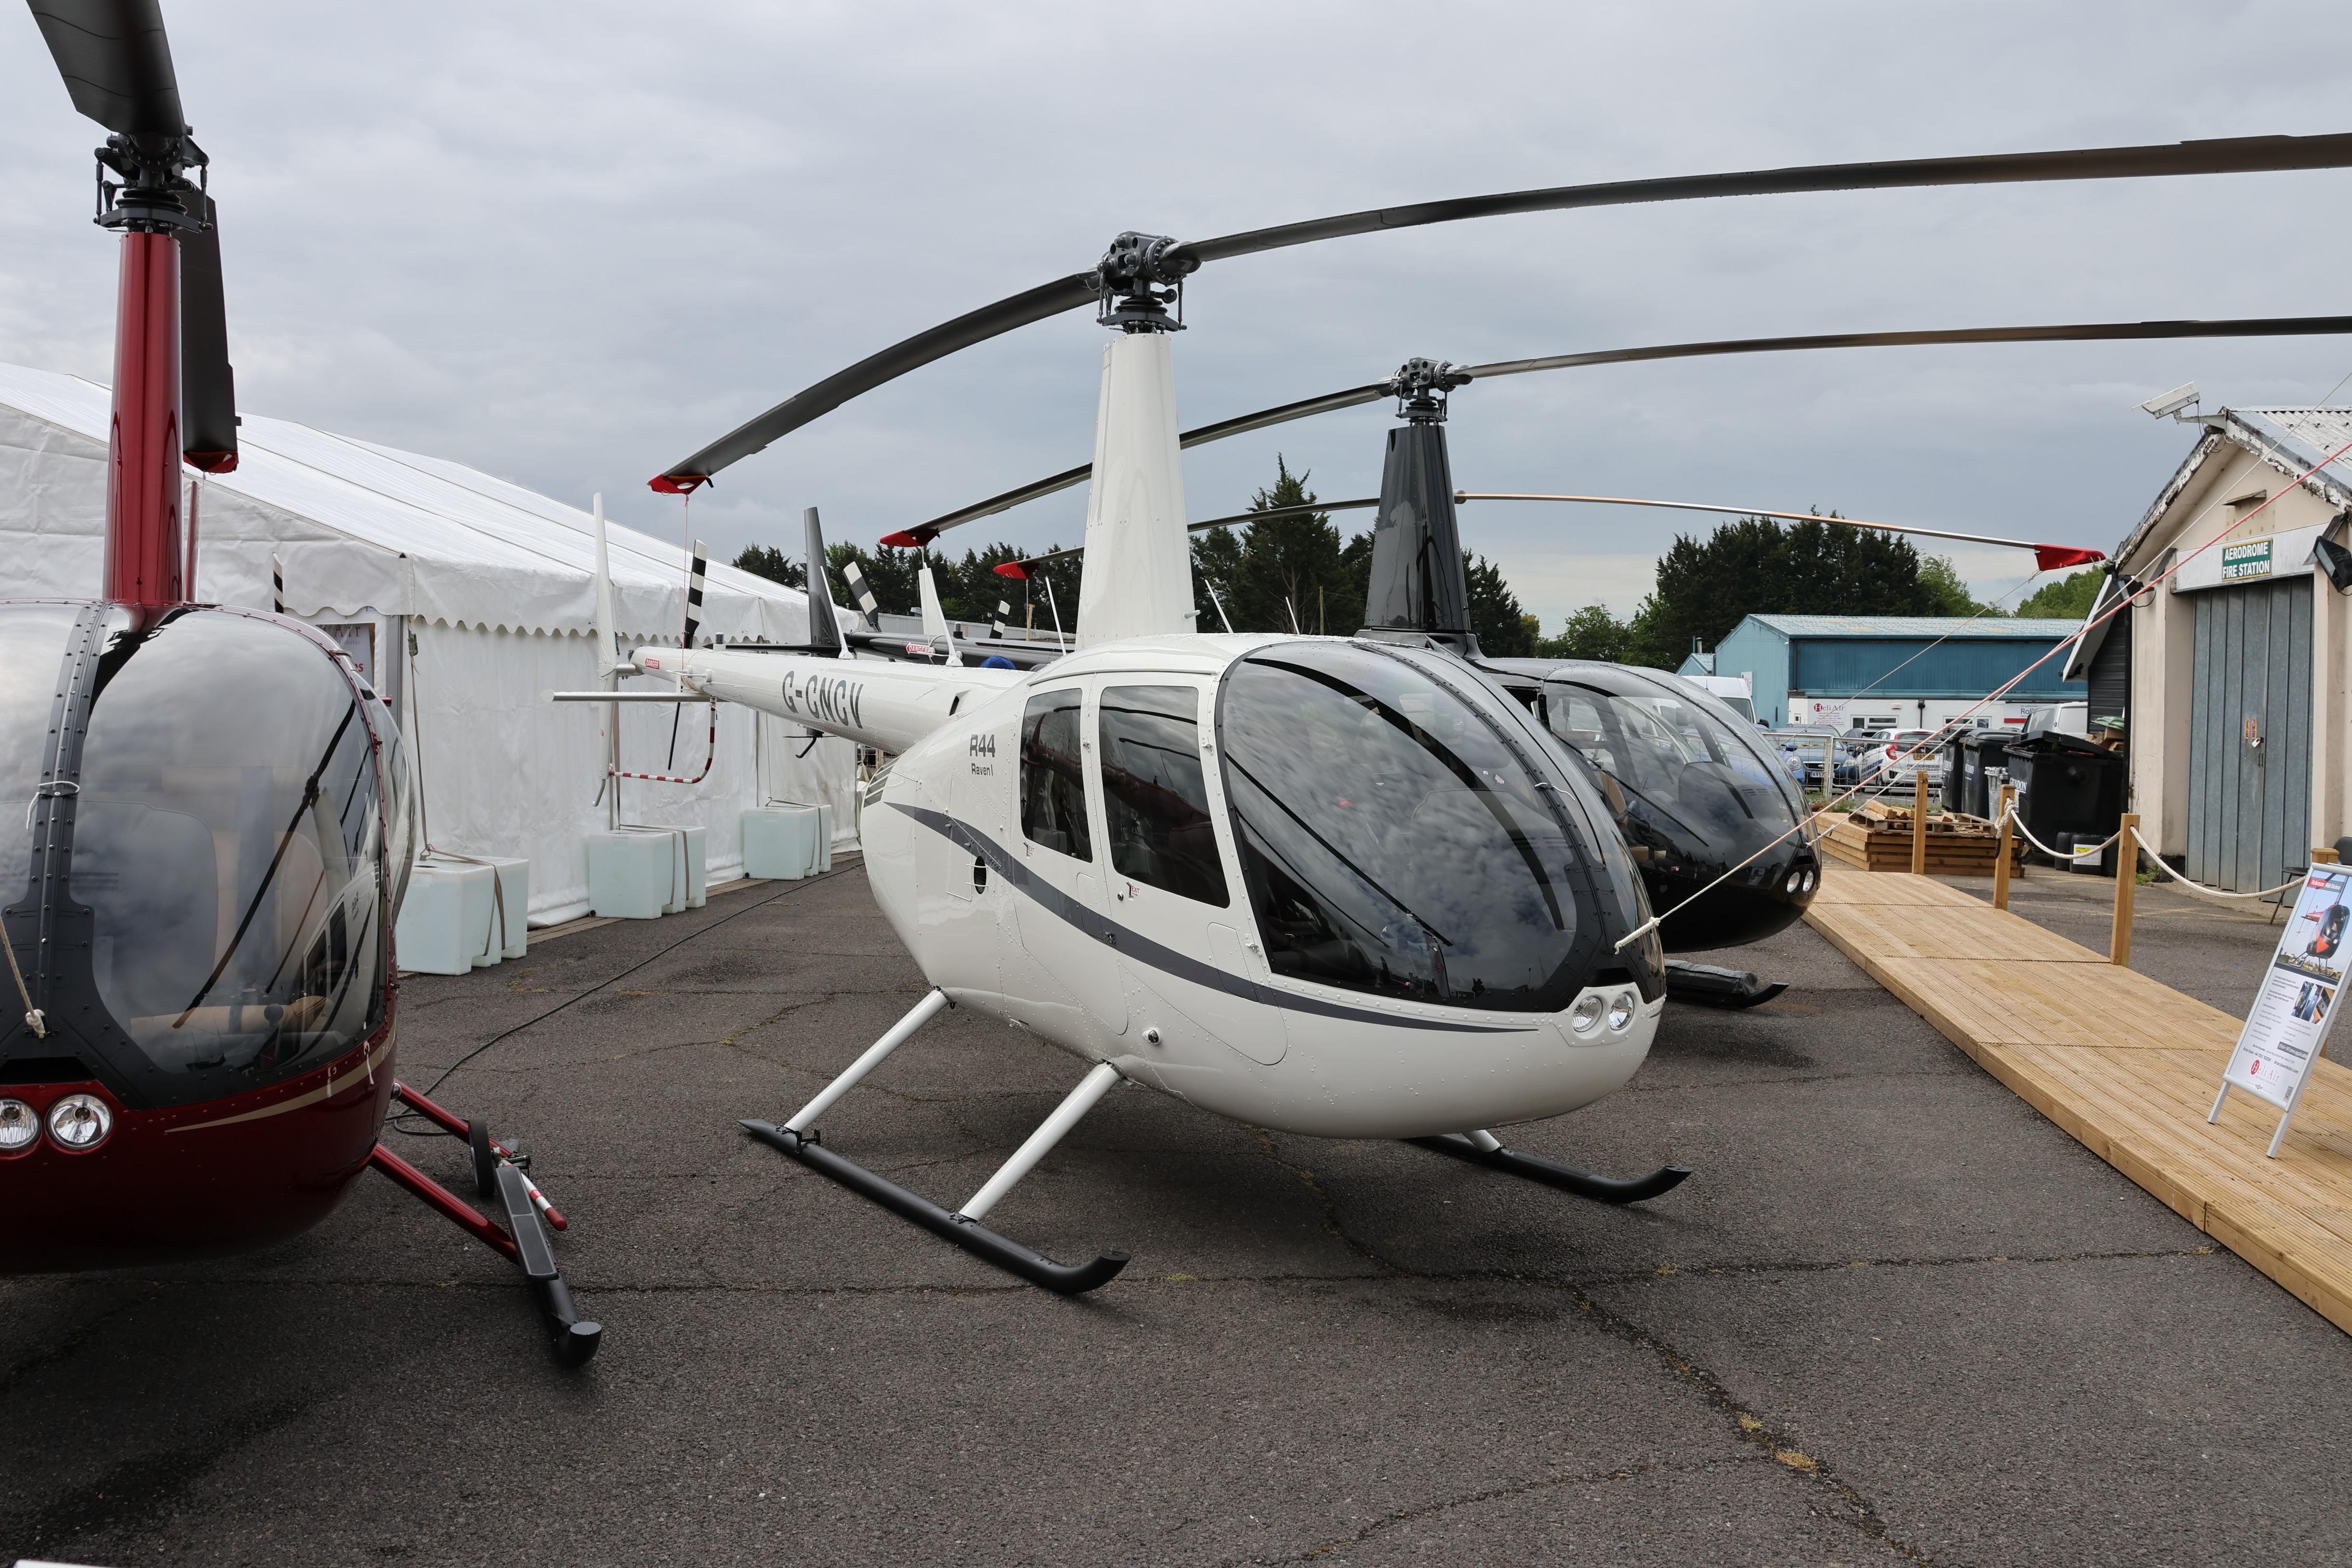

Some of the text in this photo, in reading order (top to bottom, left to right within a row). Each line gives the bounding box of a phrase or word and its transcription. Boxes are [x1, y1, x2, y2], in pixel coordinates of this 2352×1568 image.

[2224, 542, 2268, 561] AERODROME
[2223, 560, 2270, 578] FIRE STATION
[646, 658, 658, 669] DANGER
[783, 671, 864, 729] G-CNCV
[1814, 703, 1831, 712] Heli
[970, 734, 995, 757] R44
[971, 763, 990, 776] Raven
[2251, 1060, 2268, 1076] Heli
[2268, 1070, 2279, 1081] Air
